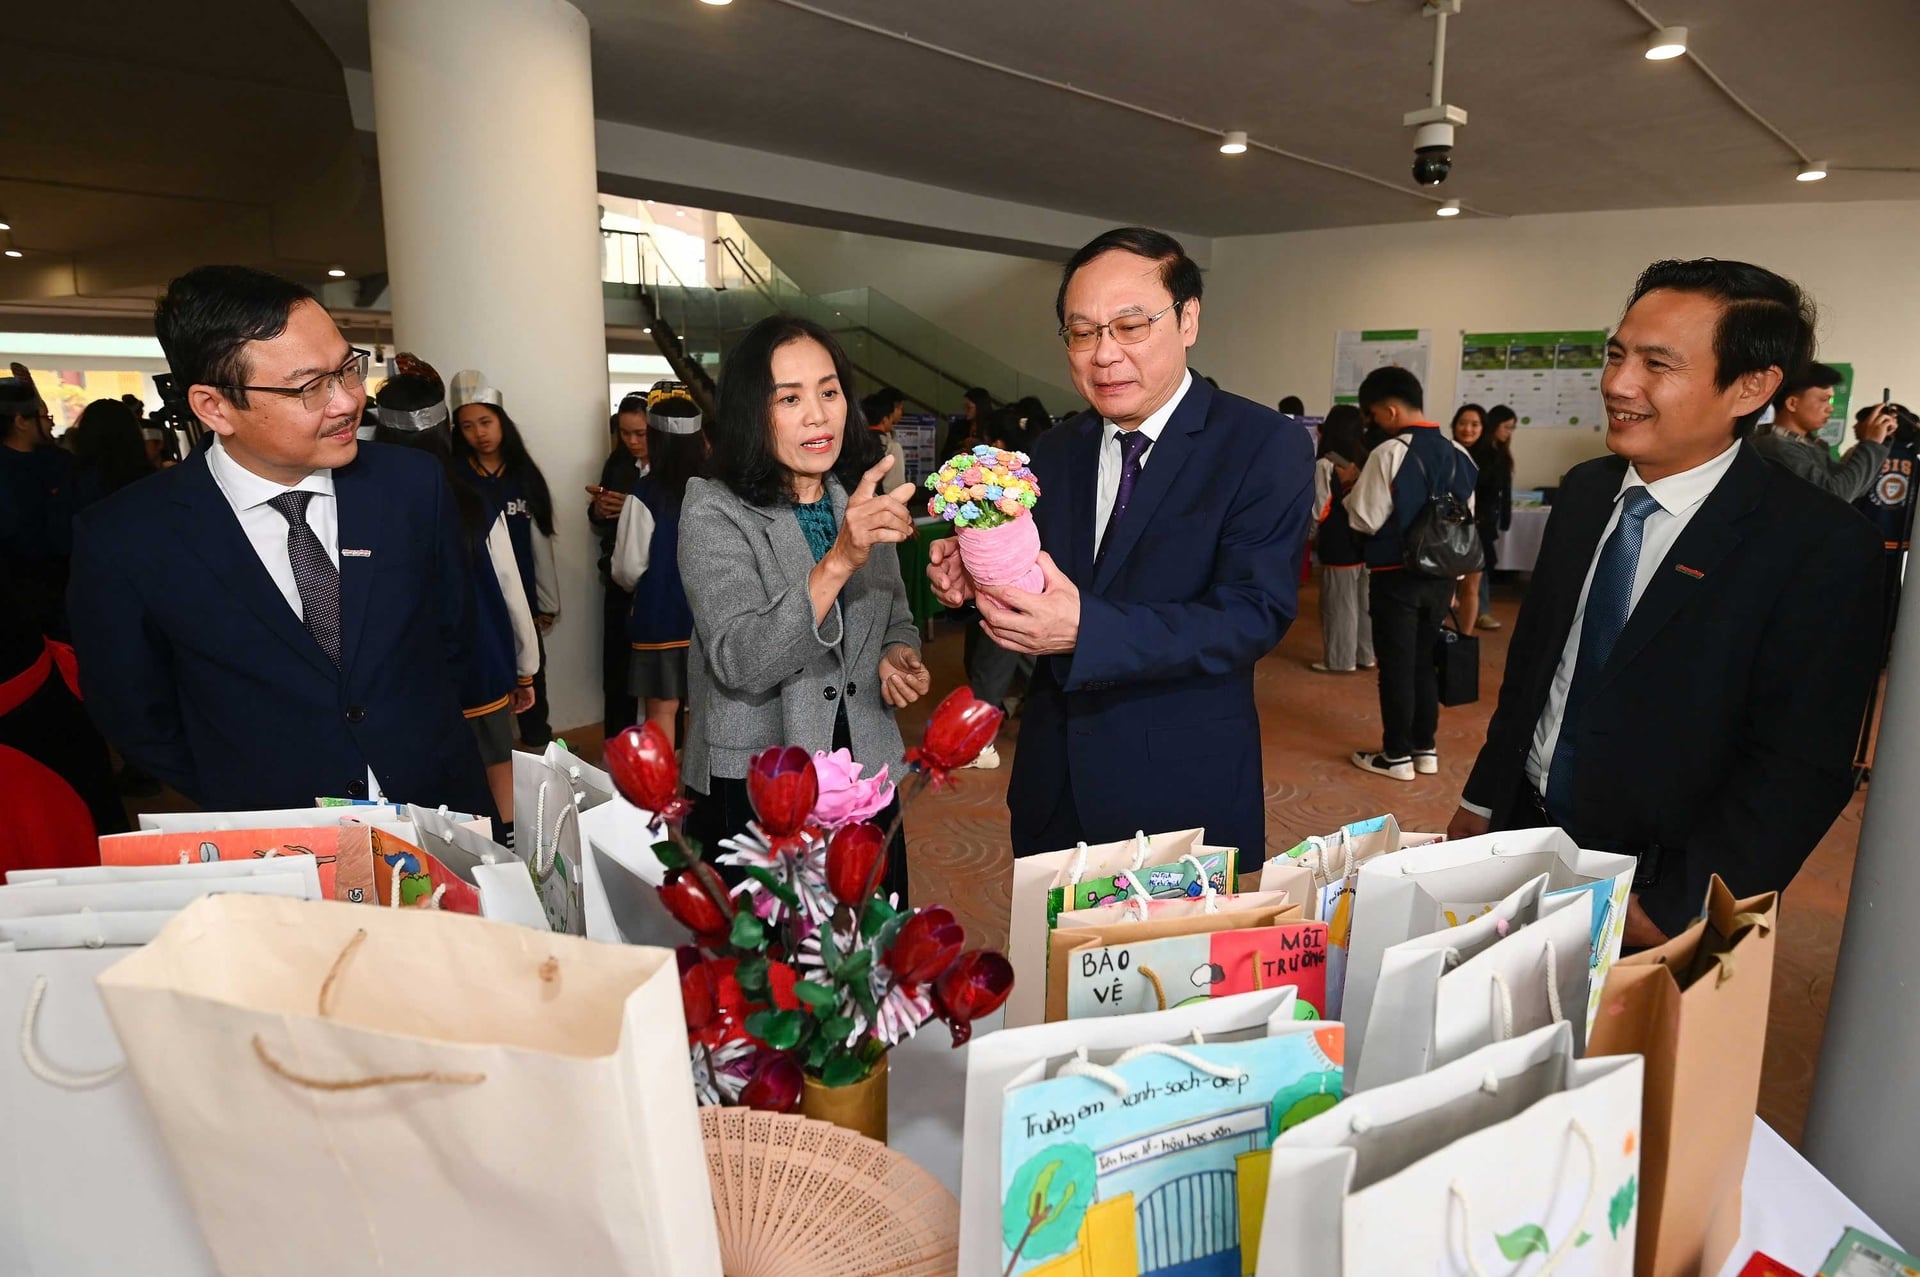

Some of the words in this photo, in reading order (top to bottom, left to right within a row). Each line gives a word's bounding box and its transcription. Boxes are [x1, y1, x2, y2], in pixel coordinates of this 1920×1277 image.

[1280, 926, 1324, 950] MÔI
[1092, 977, 1124, 1007] VỆ
[1078, 1101, 1105, 1120] em
